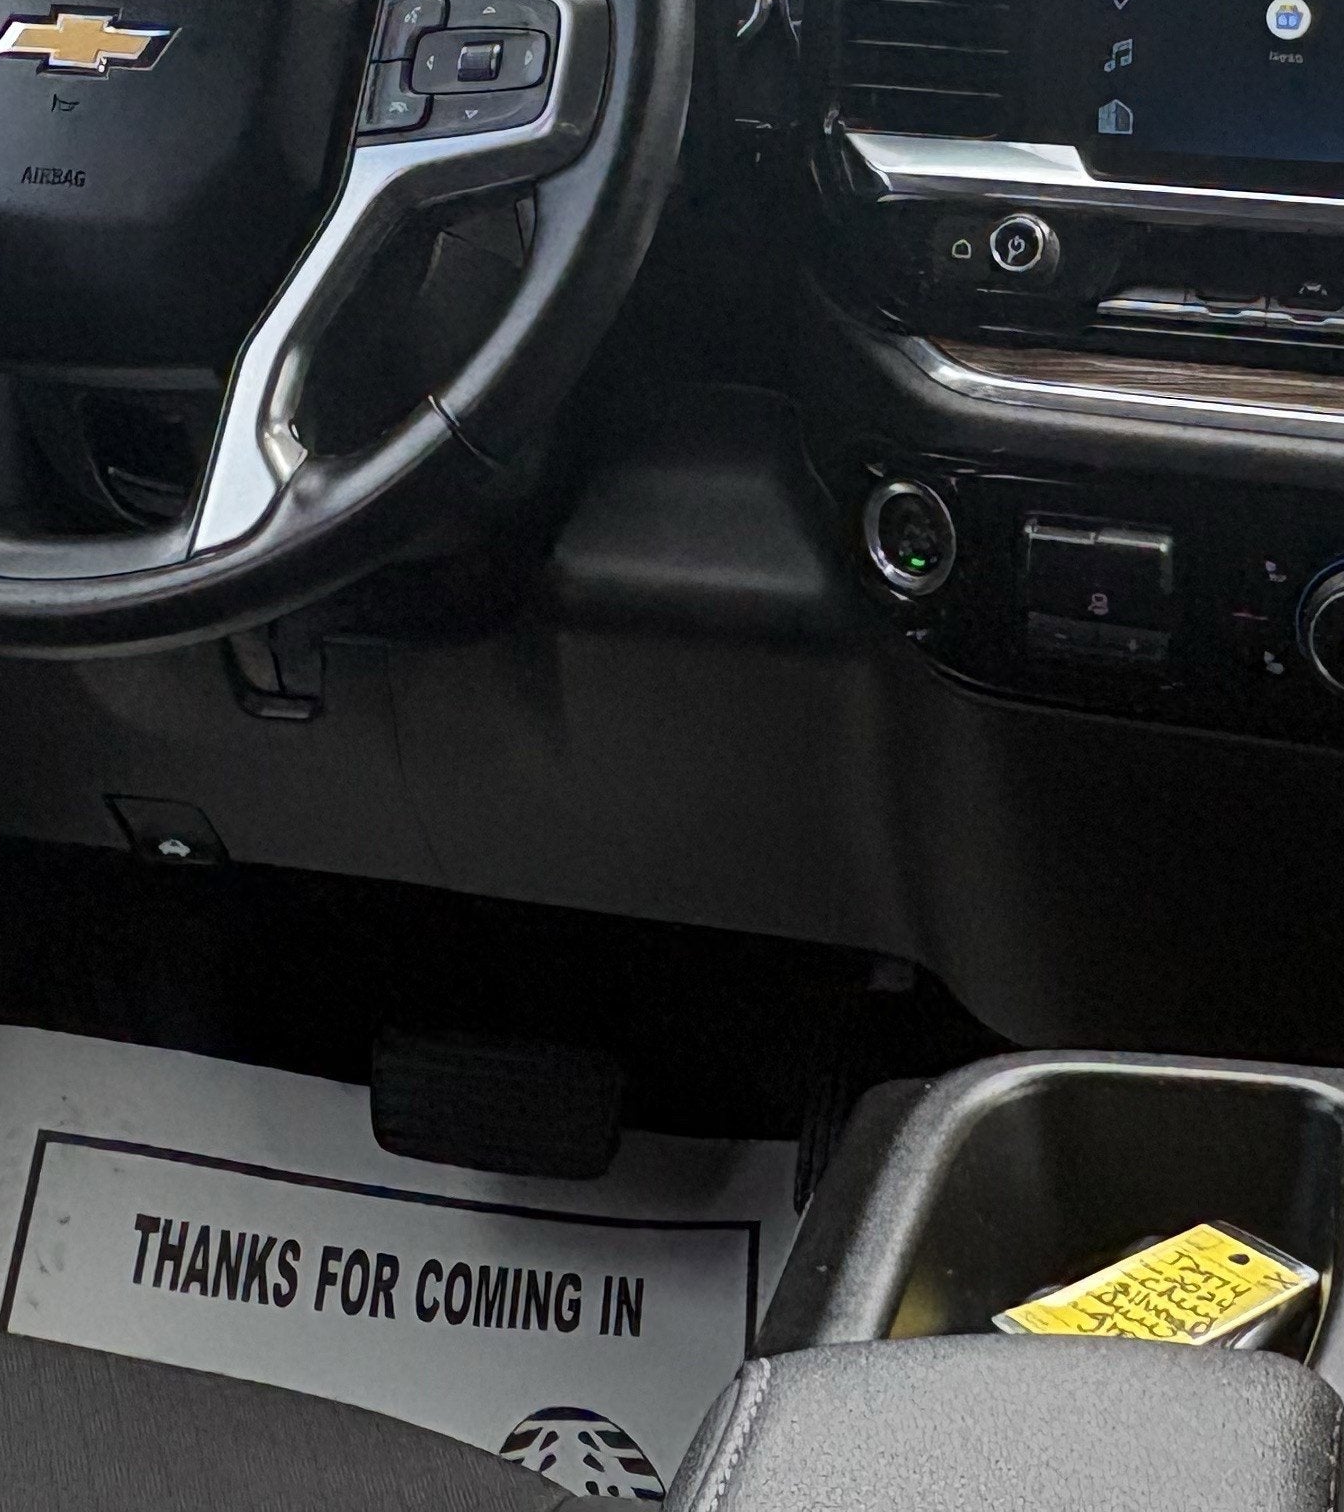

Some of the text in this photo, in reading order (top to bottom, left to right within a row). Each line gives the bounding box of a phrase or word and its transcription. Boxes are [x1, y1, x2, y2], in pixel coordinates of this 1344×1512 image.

[20, 166, 86, 187] AIRBAG
[132, 1212, 646, 1339] THANKS FOR COMING IN
